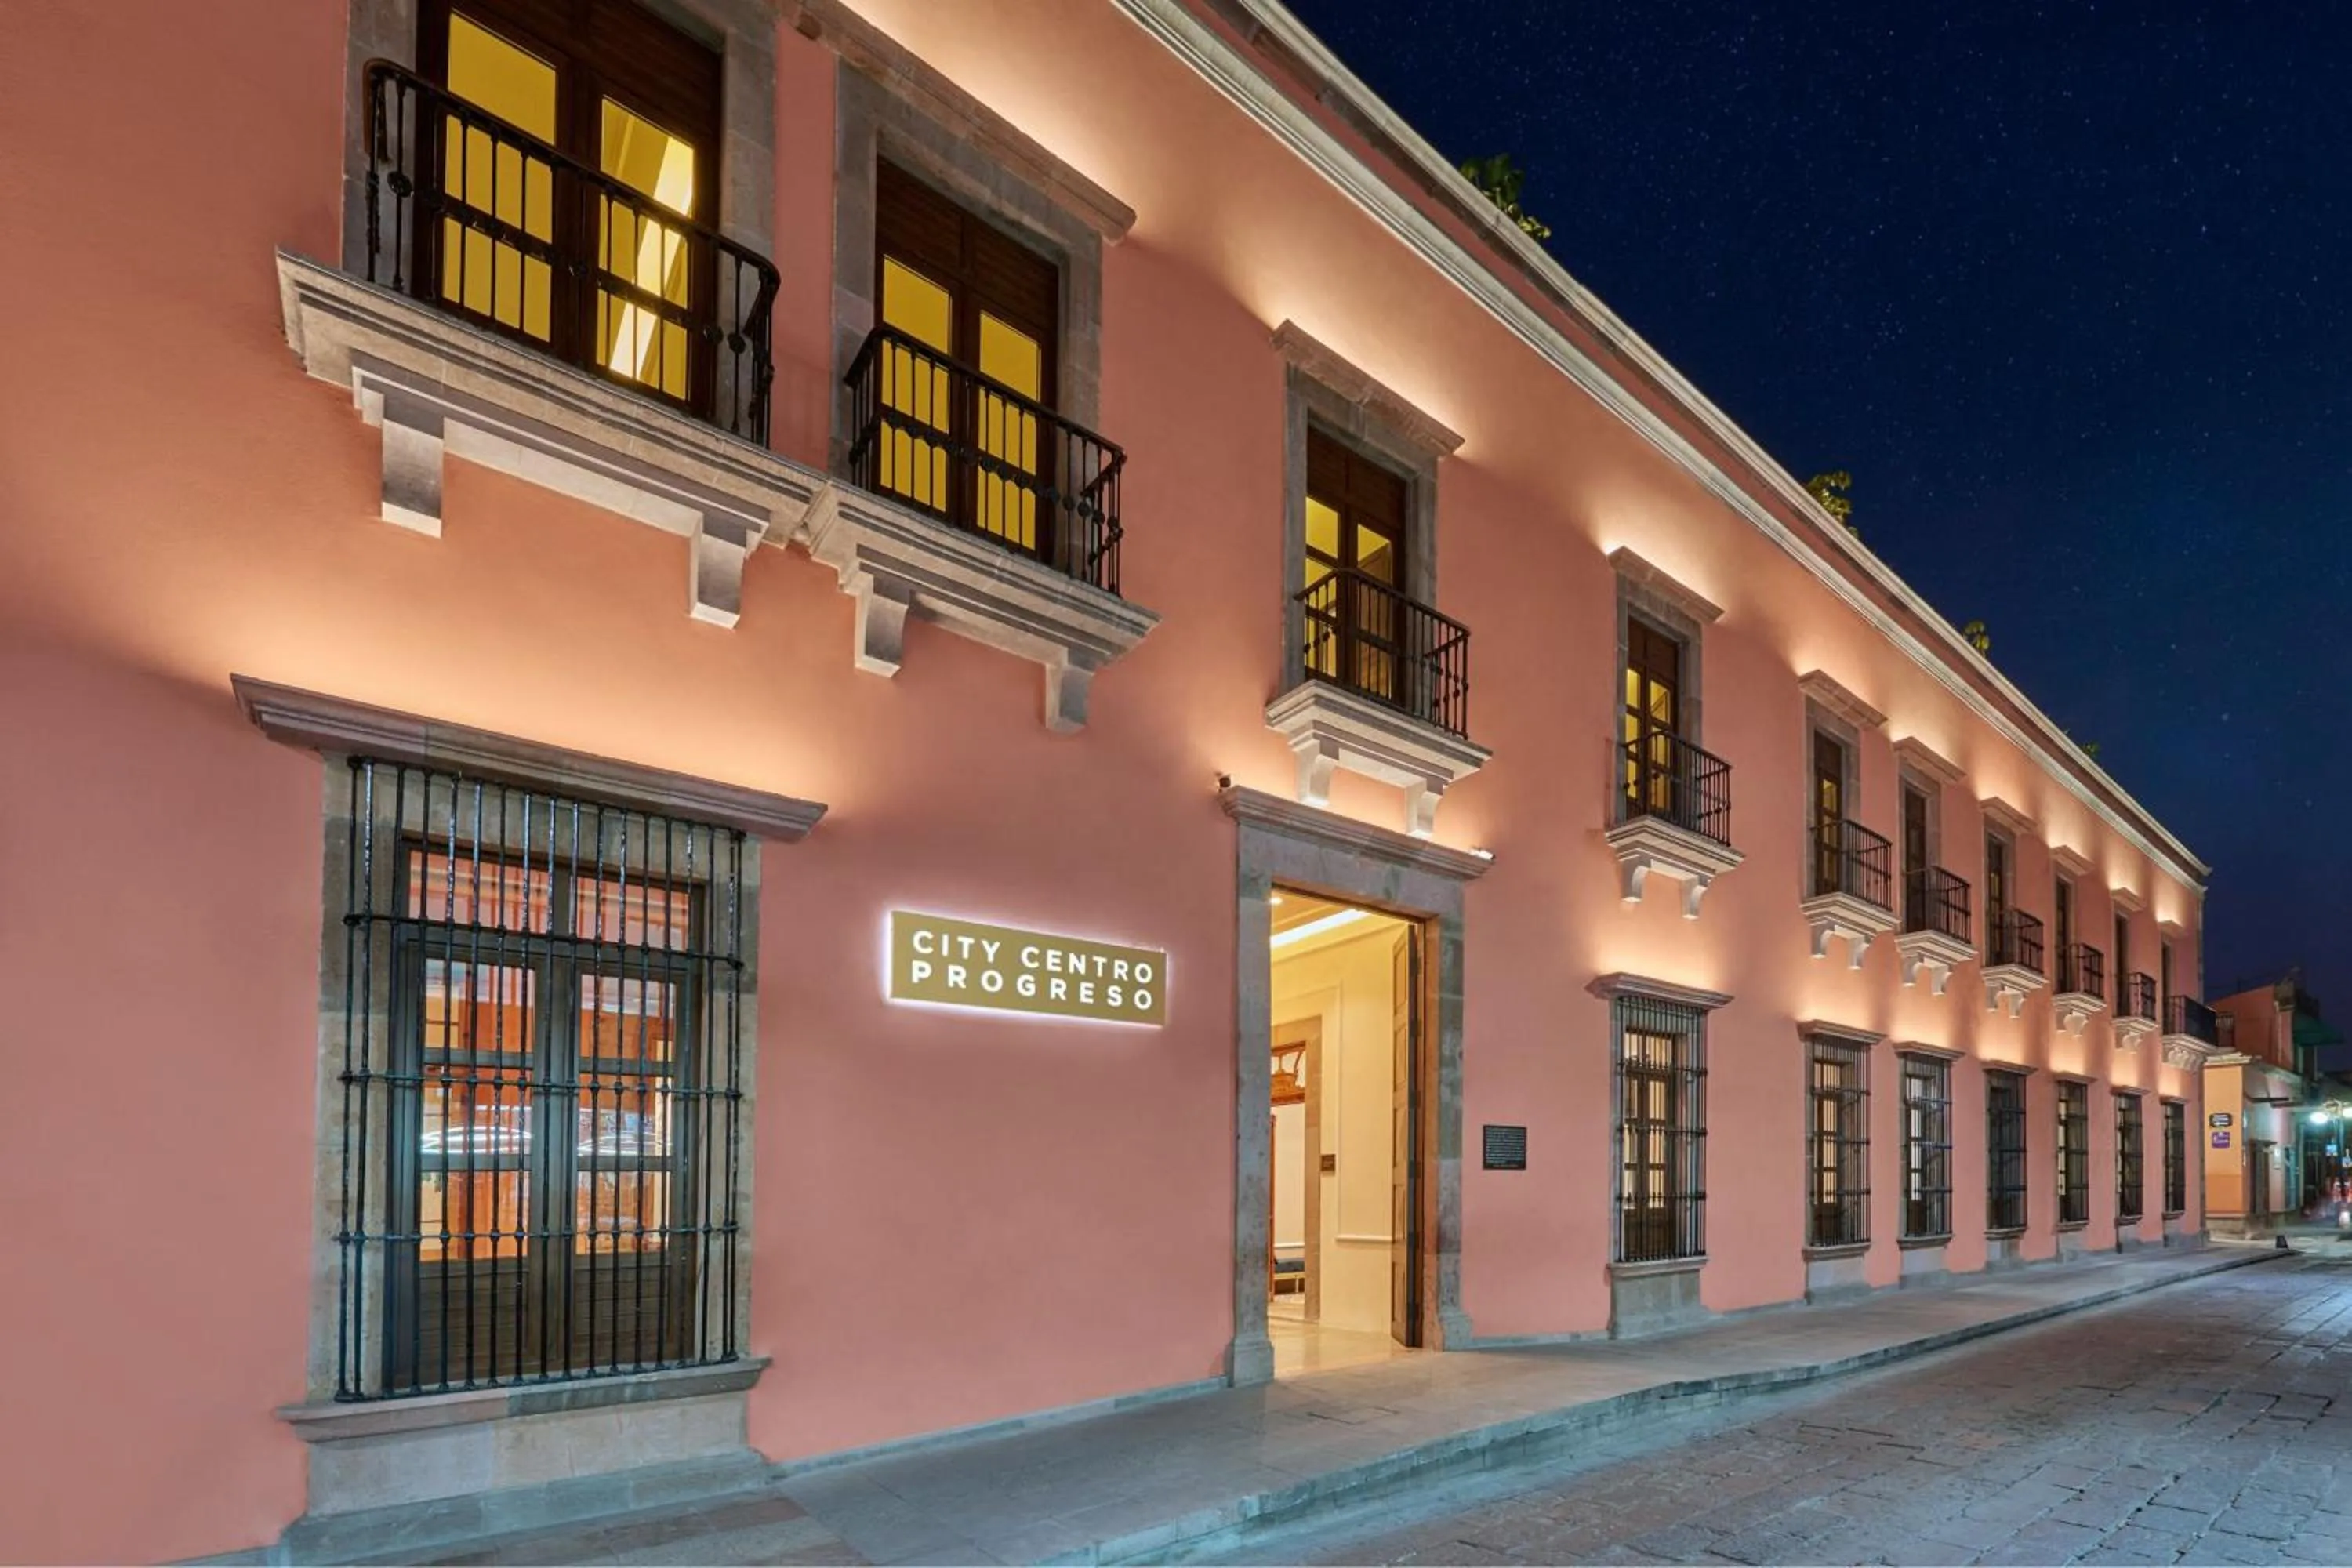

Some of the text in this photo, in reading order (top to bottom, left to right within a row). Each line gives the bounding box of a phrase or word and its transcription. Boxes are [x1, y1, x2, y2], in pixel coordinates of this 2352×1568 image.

[912, 931, 1152, 983] CITY CENTRO
[911, 960, 1152, 1010] PROGRESO
